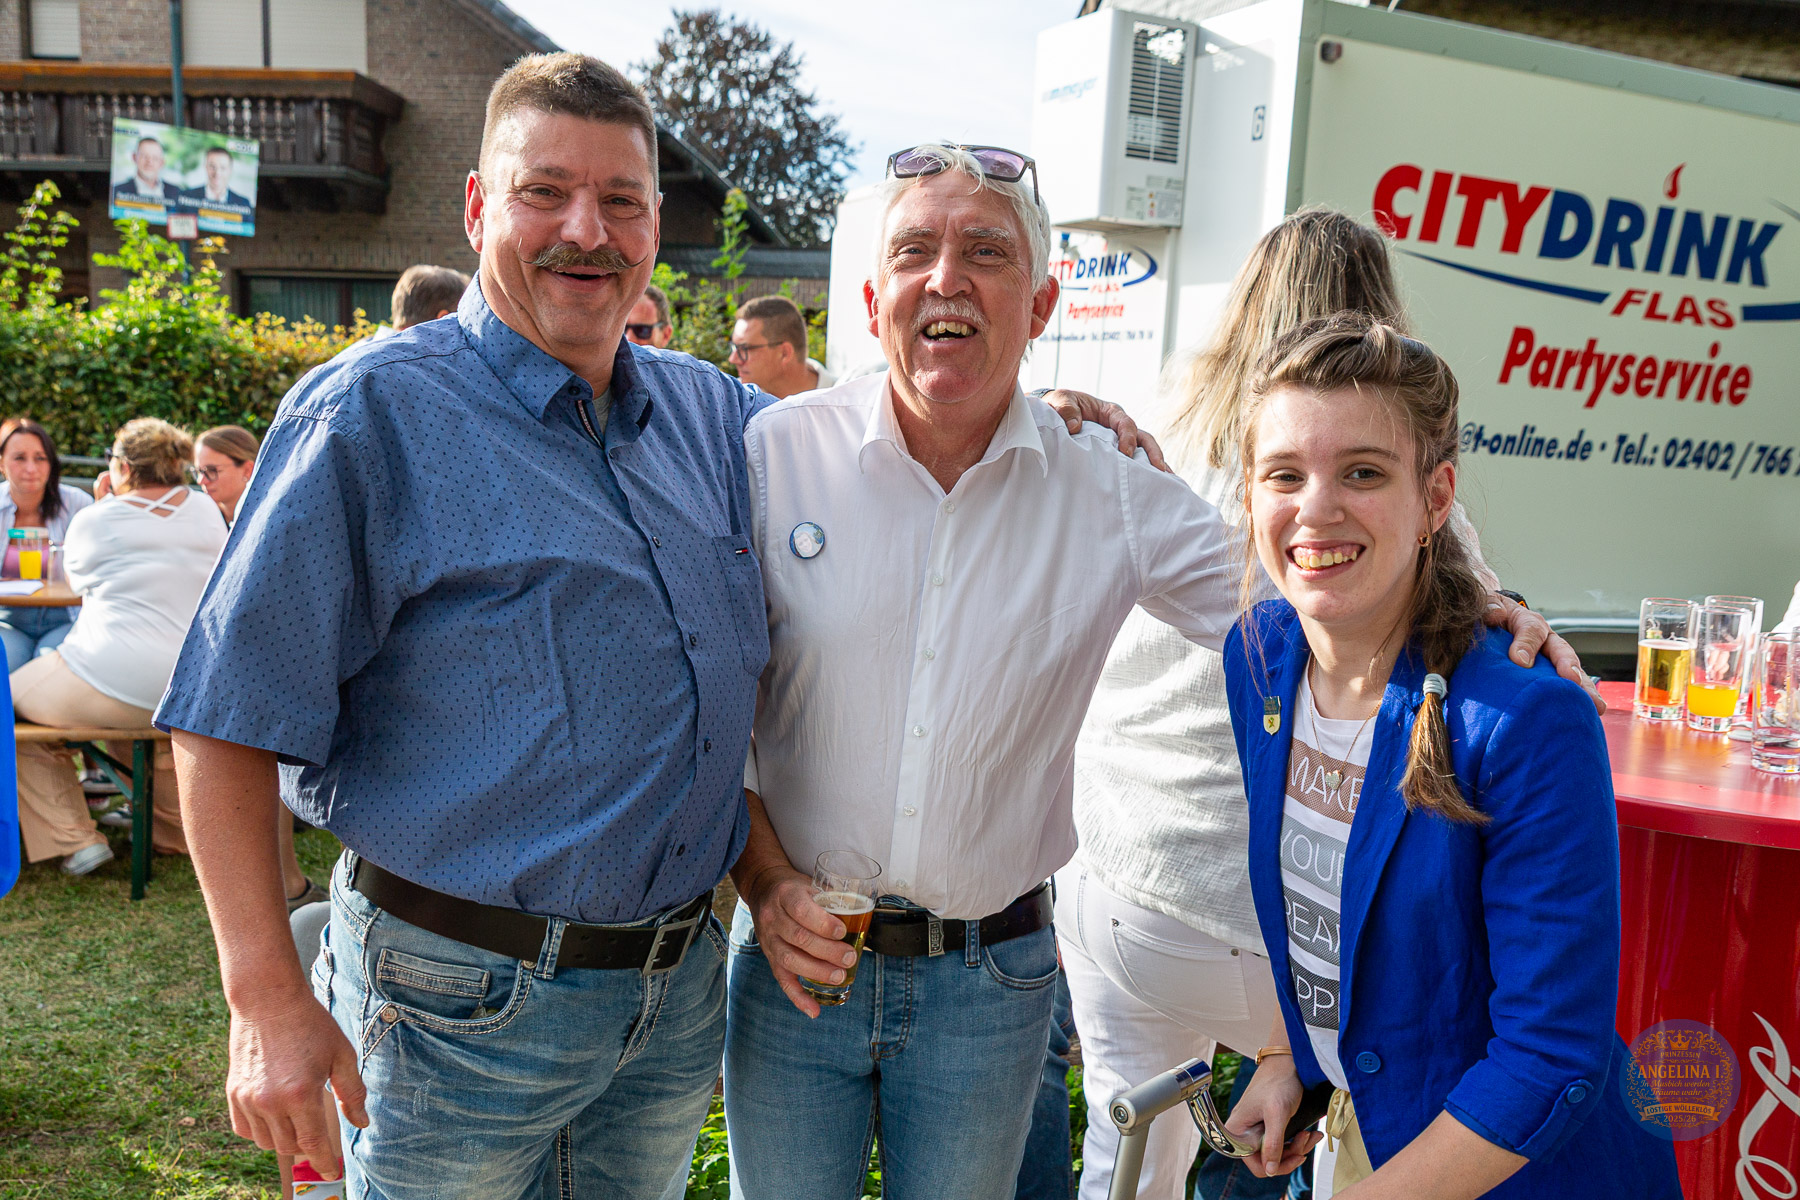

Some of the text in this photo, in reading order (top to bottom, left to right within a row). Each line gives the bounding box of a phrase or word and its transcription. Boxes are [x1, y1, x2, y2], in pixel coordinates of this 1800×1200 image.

[1372, 163, 1783, 289] CITYDRINK
[1048, 251, 1132, 280] ITYDRINK
[1610, 288, 1736, 330] FLAS
[1498, 326, 1753, 410] Partyservice
[1612, 431, 1659, 466] Tel.:
